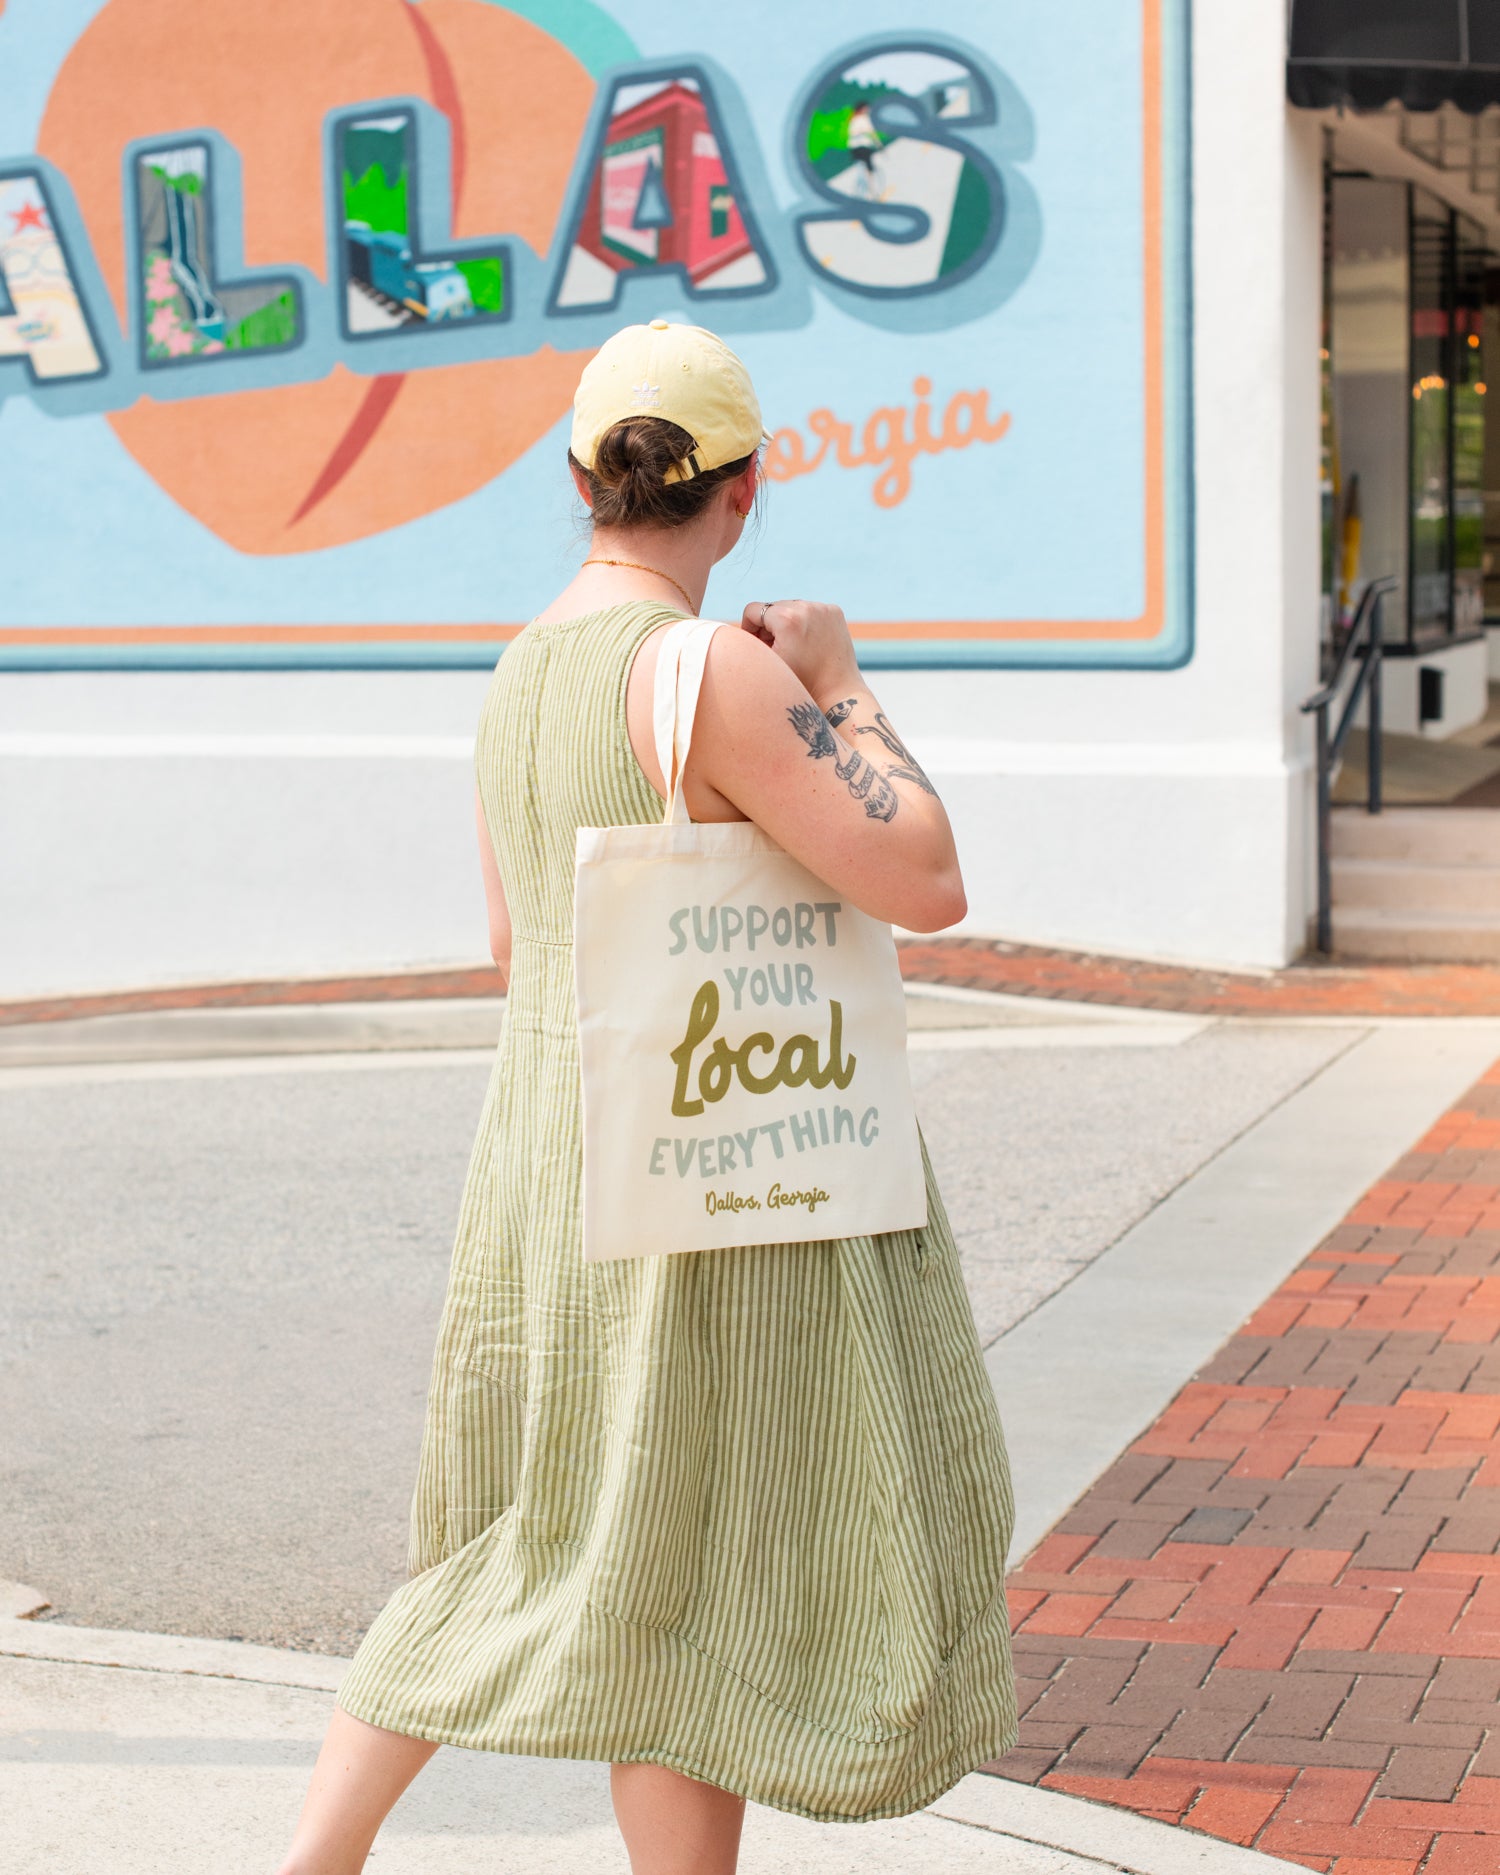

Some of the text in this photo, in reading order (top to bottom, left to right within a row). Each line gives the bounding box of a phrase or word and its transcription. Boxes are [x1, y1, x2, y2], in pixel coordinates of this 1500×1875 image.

[757, 375, 1012, 510] orgia
[668, 902, 842, 956] SUPPORT
[723, 963, 818, 1011] YOUR
[648, 1105, 879, 1179] EVERYTHING
[705, 1183, 830, 1216] Dallas, Georgia
